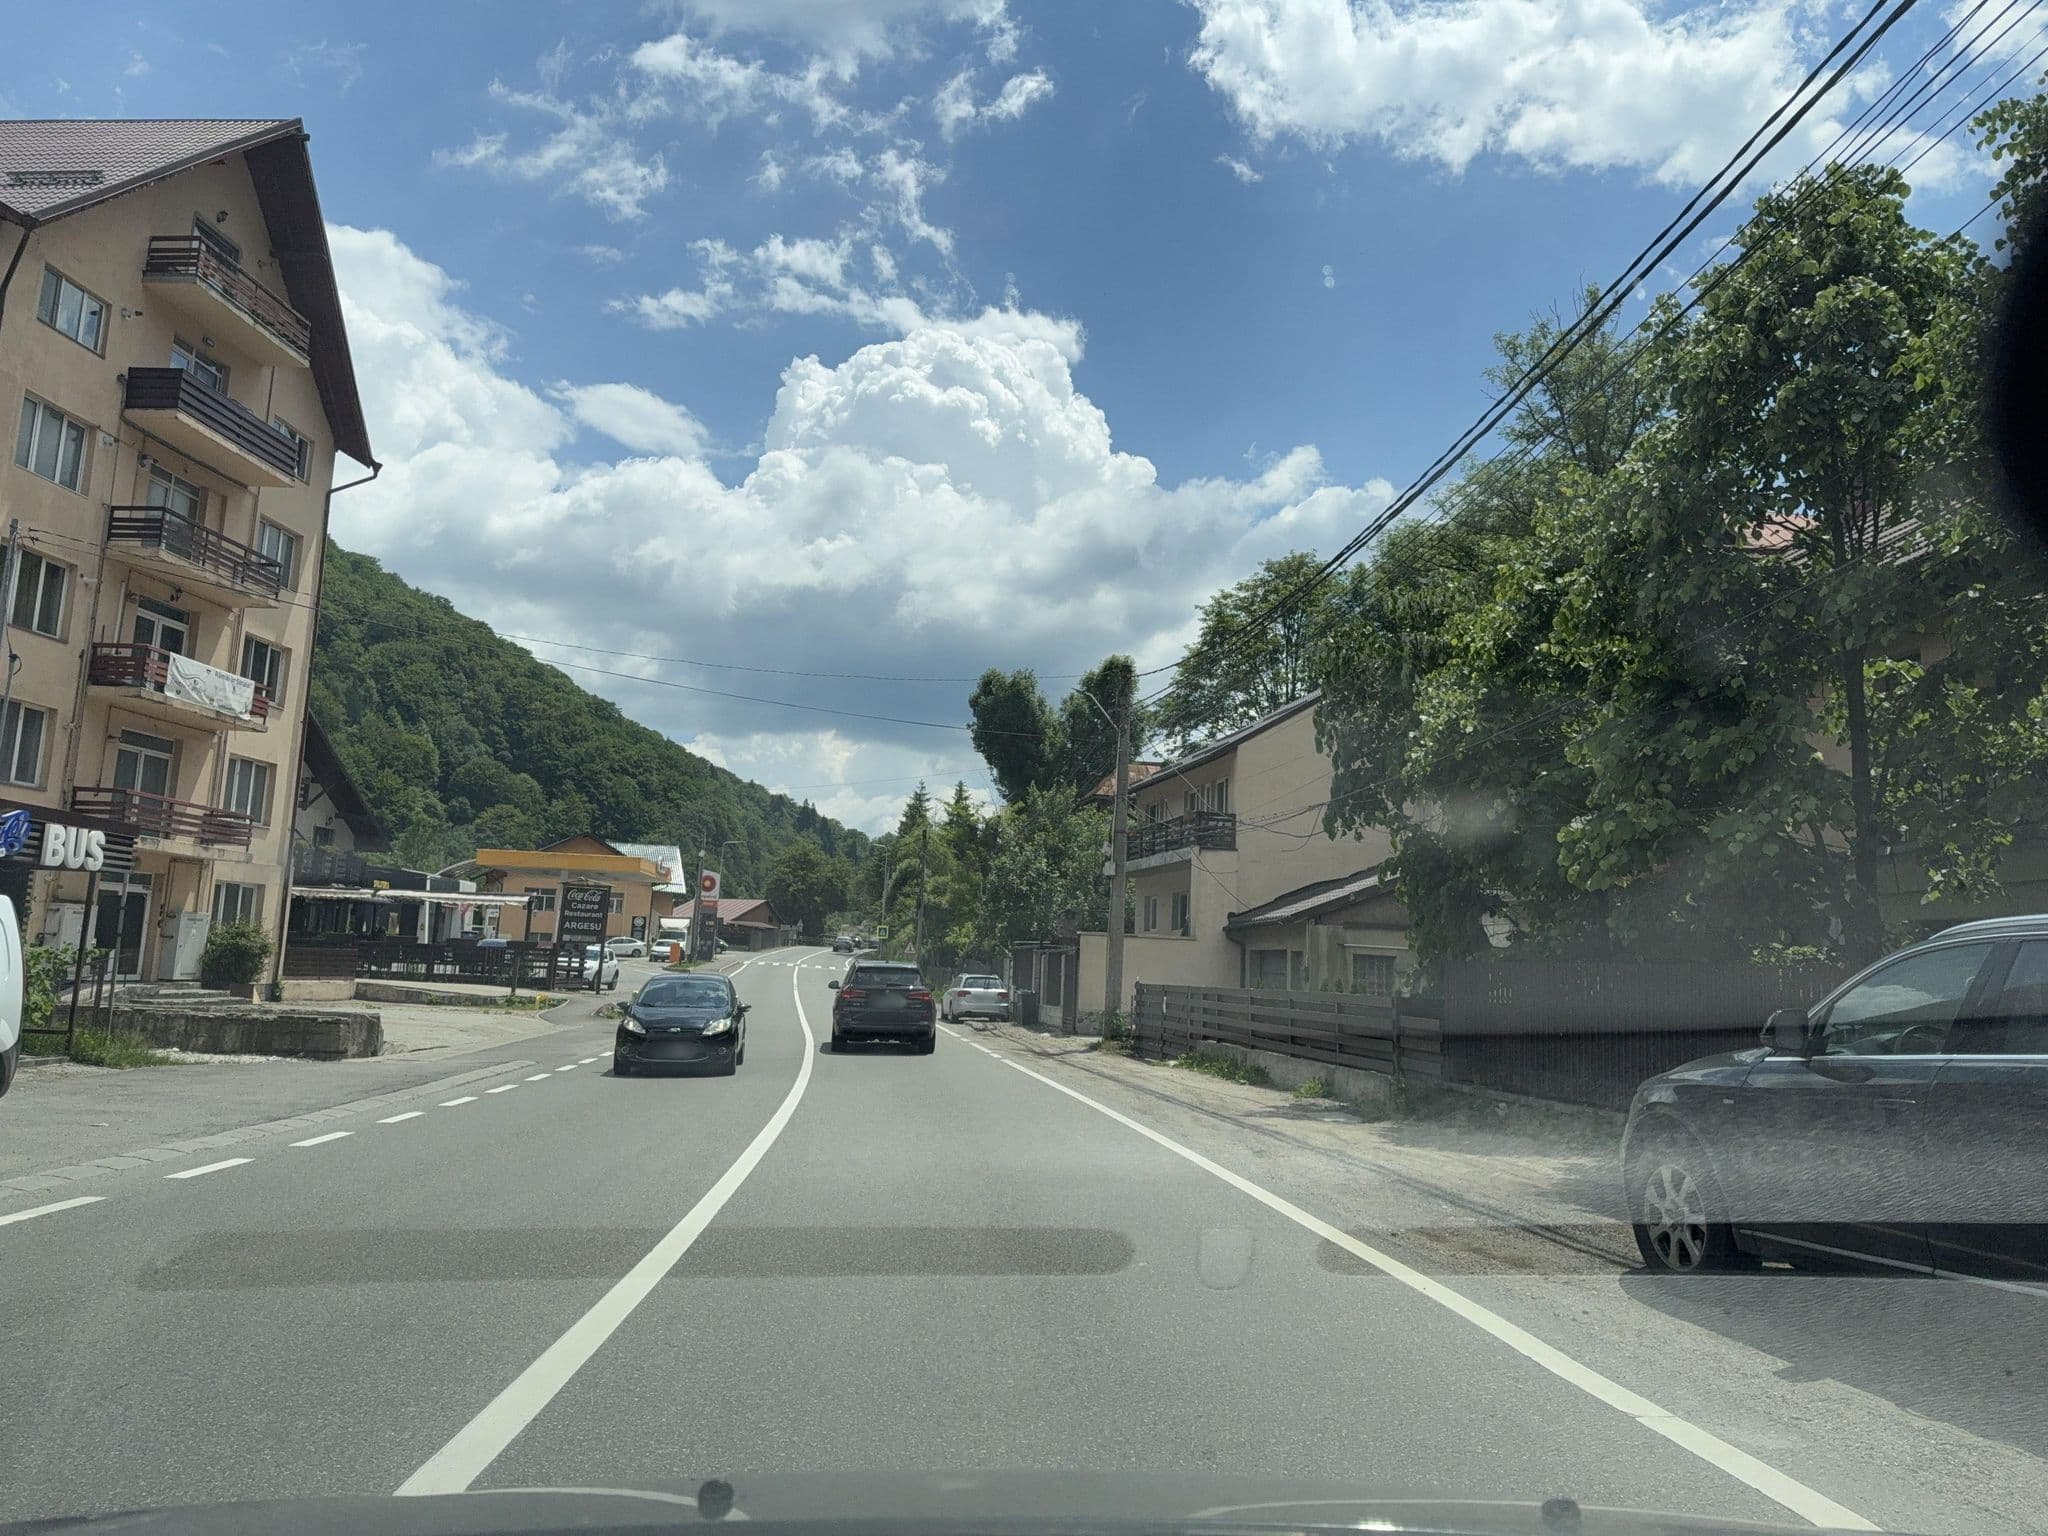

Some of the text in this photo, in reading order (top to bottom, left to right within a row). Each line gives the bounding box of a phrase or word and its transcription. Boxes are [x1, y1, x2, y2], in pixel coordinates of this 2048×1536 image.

[40, 823, 106, 872] BUS
[571, 902, 599, 910] Cazare
[564, 910, 603, 918] Restaurant
[563, 921, 602, 931] ARGESU
